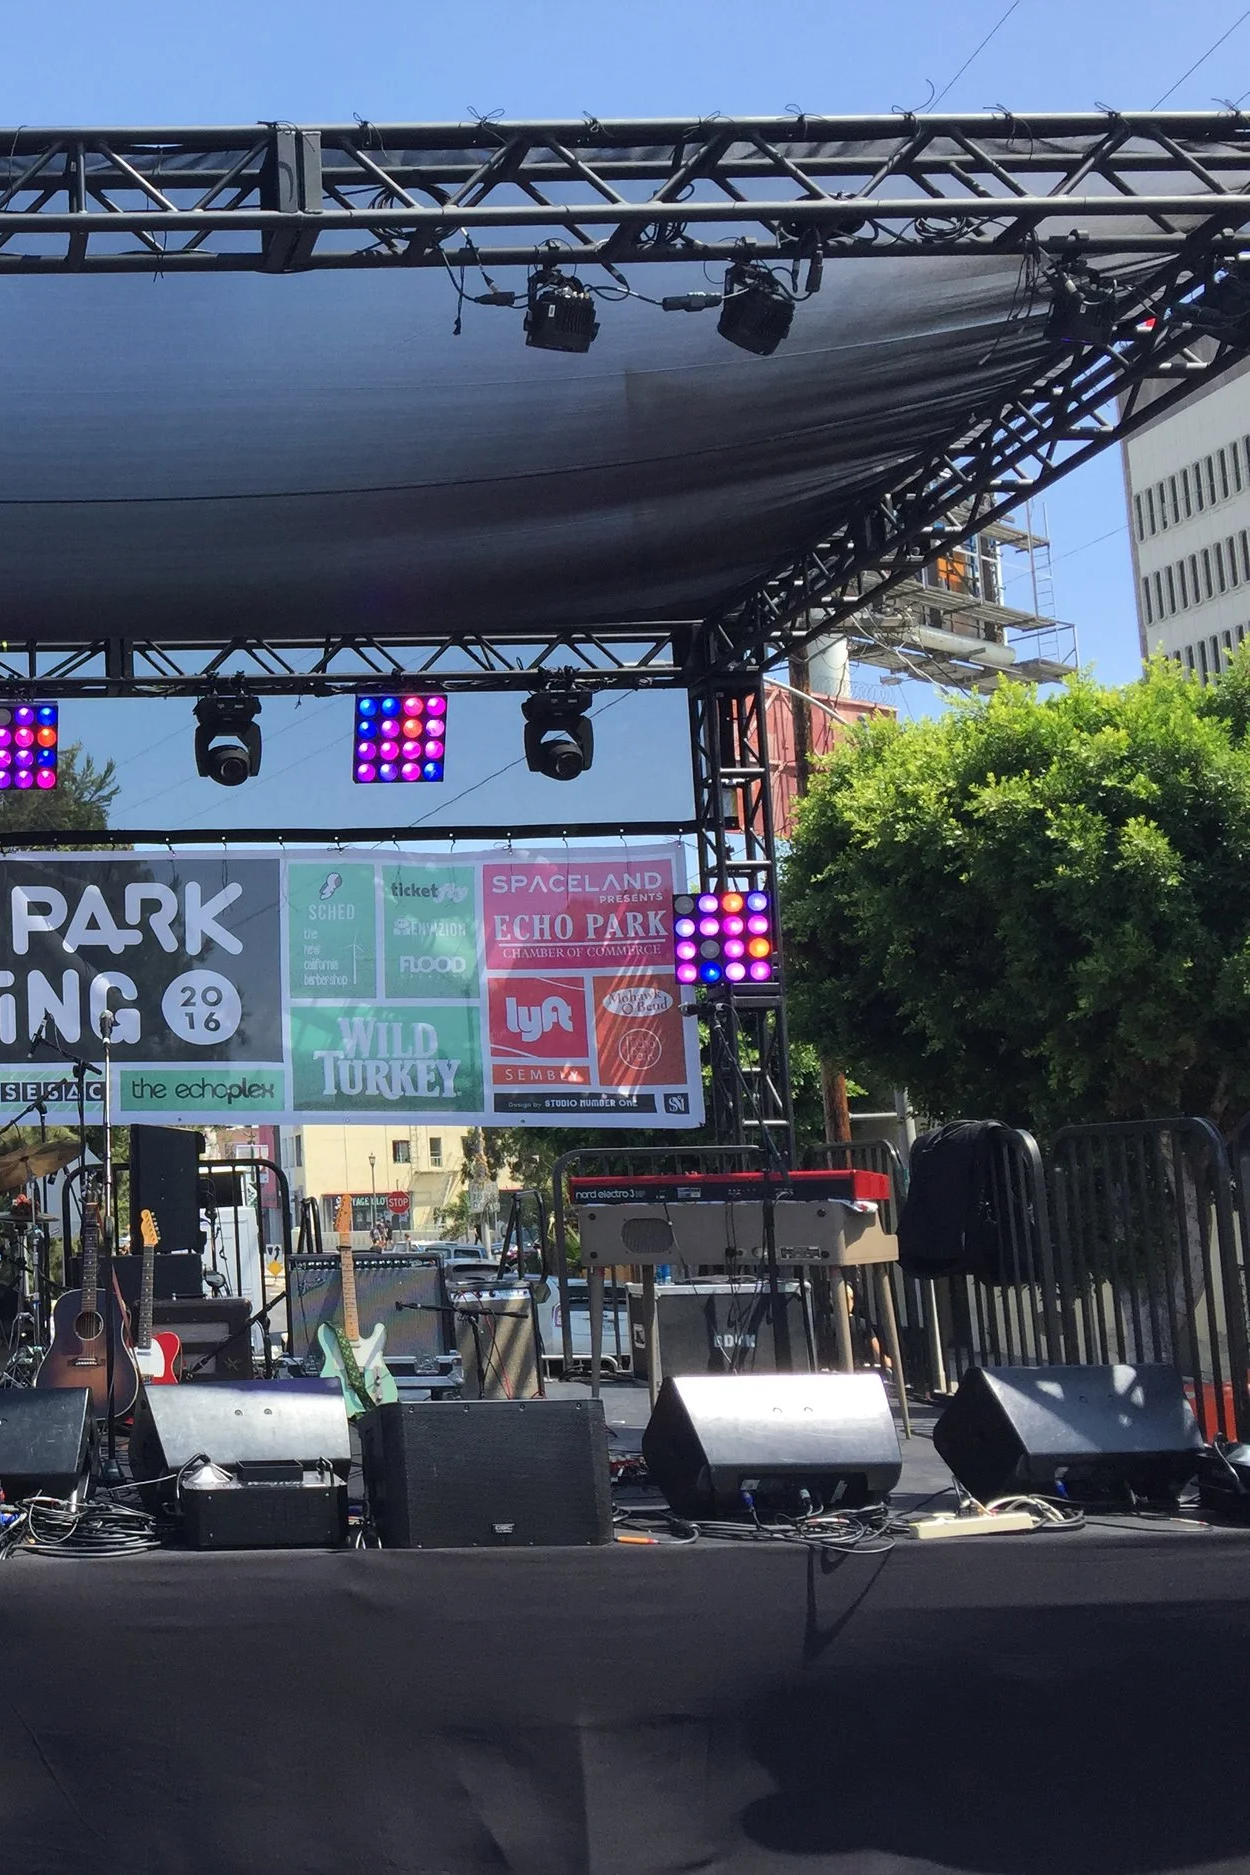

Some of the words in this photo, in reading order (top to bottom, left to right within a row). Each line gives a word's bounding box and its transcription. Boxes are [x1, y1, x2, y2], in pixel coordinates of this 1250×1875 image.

[492, 872, 662, 894] SPACELAND
[600, 893, 663, 904] PRESENTS
[11, 881, 244, 956] PARK
[308, 904, 355, 920] SCHED
[304, 928, 318, 940] the
[494, 914, 574, 941] ECHO
[586, 910, 668, 940] PARK
[503, 946, 563, 959] CHAMBER
[567, 946, 584, 957] OF
[587, 944, 661, 957] COMMERCE
[400, 955, 466, 973] FLOOD
[304, 973, 348, 987] barbershop
[180, 985, 222, 1007] 20
[609, 989, 662, 1005] Mohawk
[185, 1011, 222, 1032] 16
[506, 996, 573, 1042] lyft
[337, 1017, 438, 1060] WILD
[313, 1050, 461, 1100] TURKEY
[505, 1068, 579, 1082] SEMBLY
[132, 1078, 166, 1098] the
[175, 1077, 274, 1104] echoplex
[544, 1099, 577, 1108] STUDIO
[580, 1098, 616, 1107] NUMBER
[618, 1098, 638, 1107] ONE
[389, 1198, 409, 1207] STOP
[575, 1190, 597, 1199] nord
[598, 1190, 629, 1199] electro
